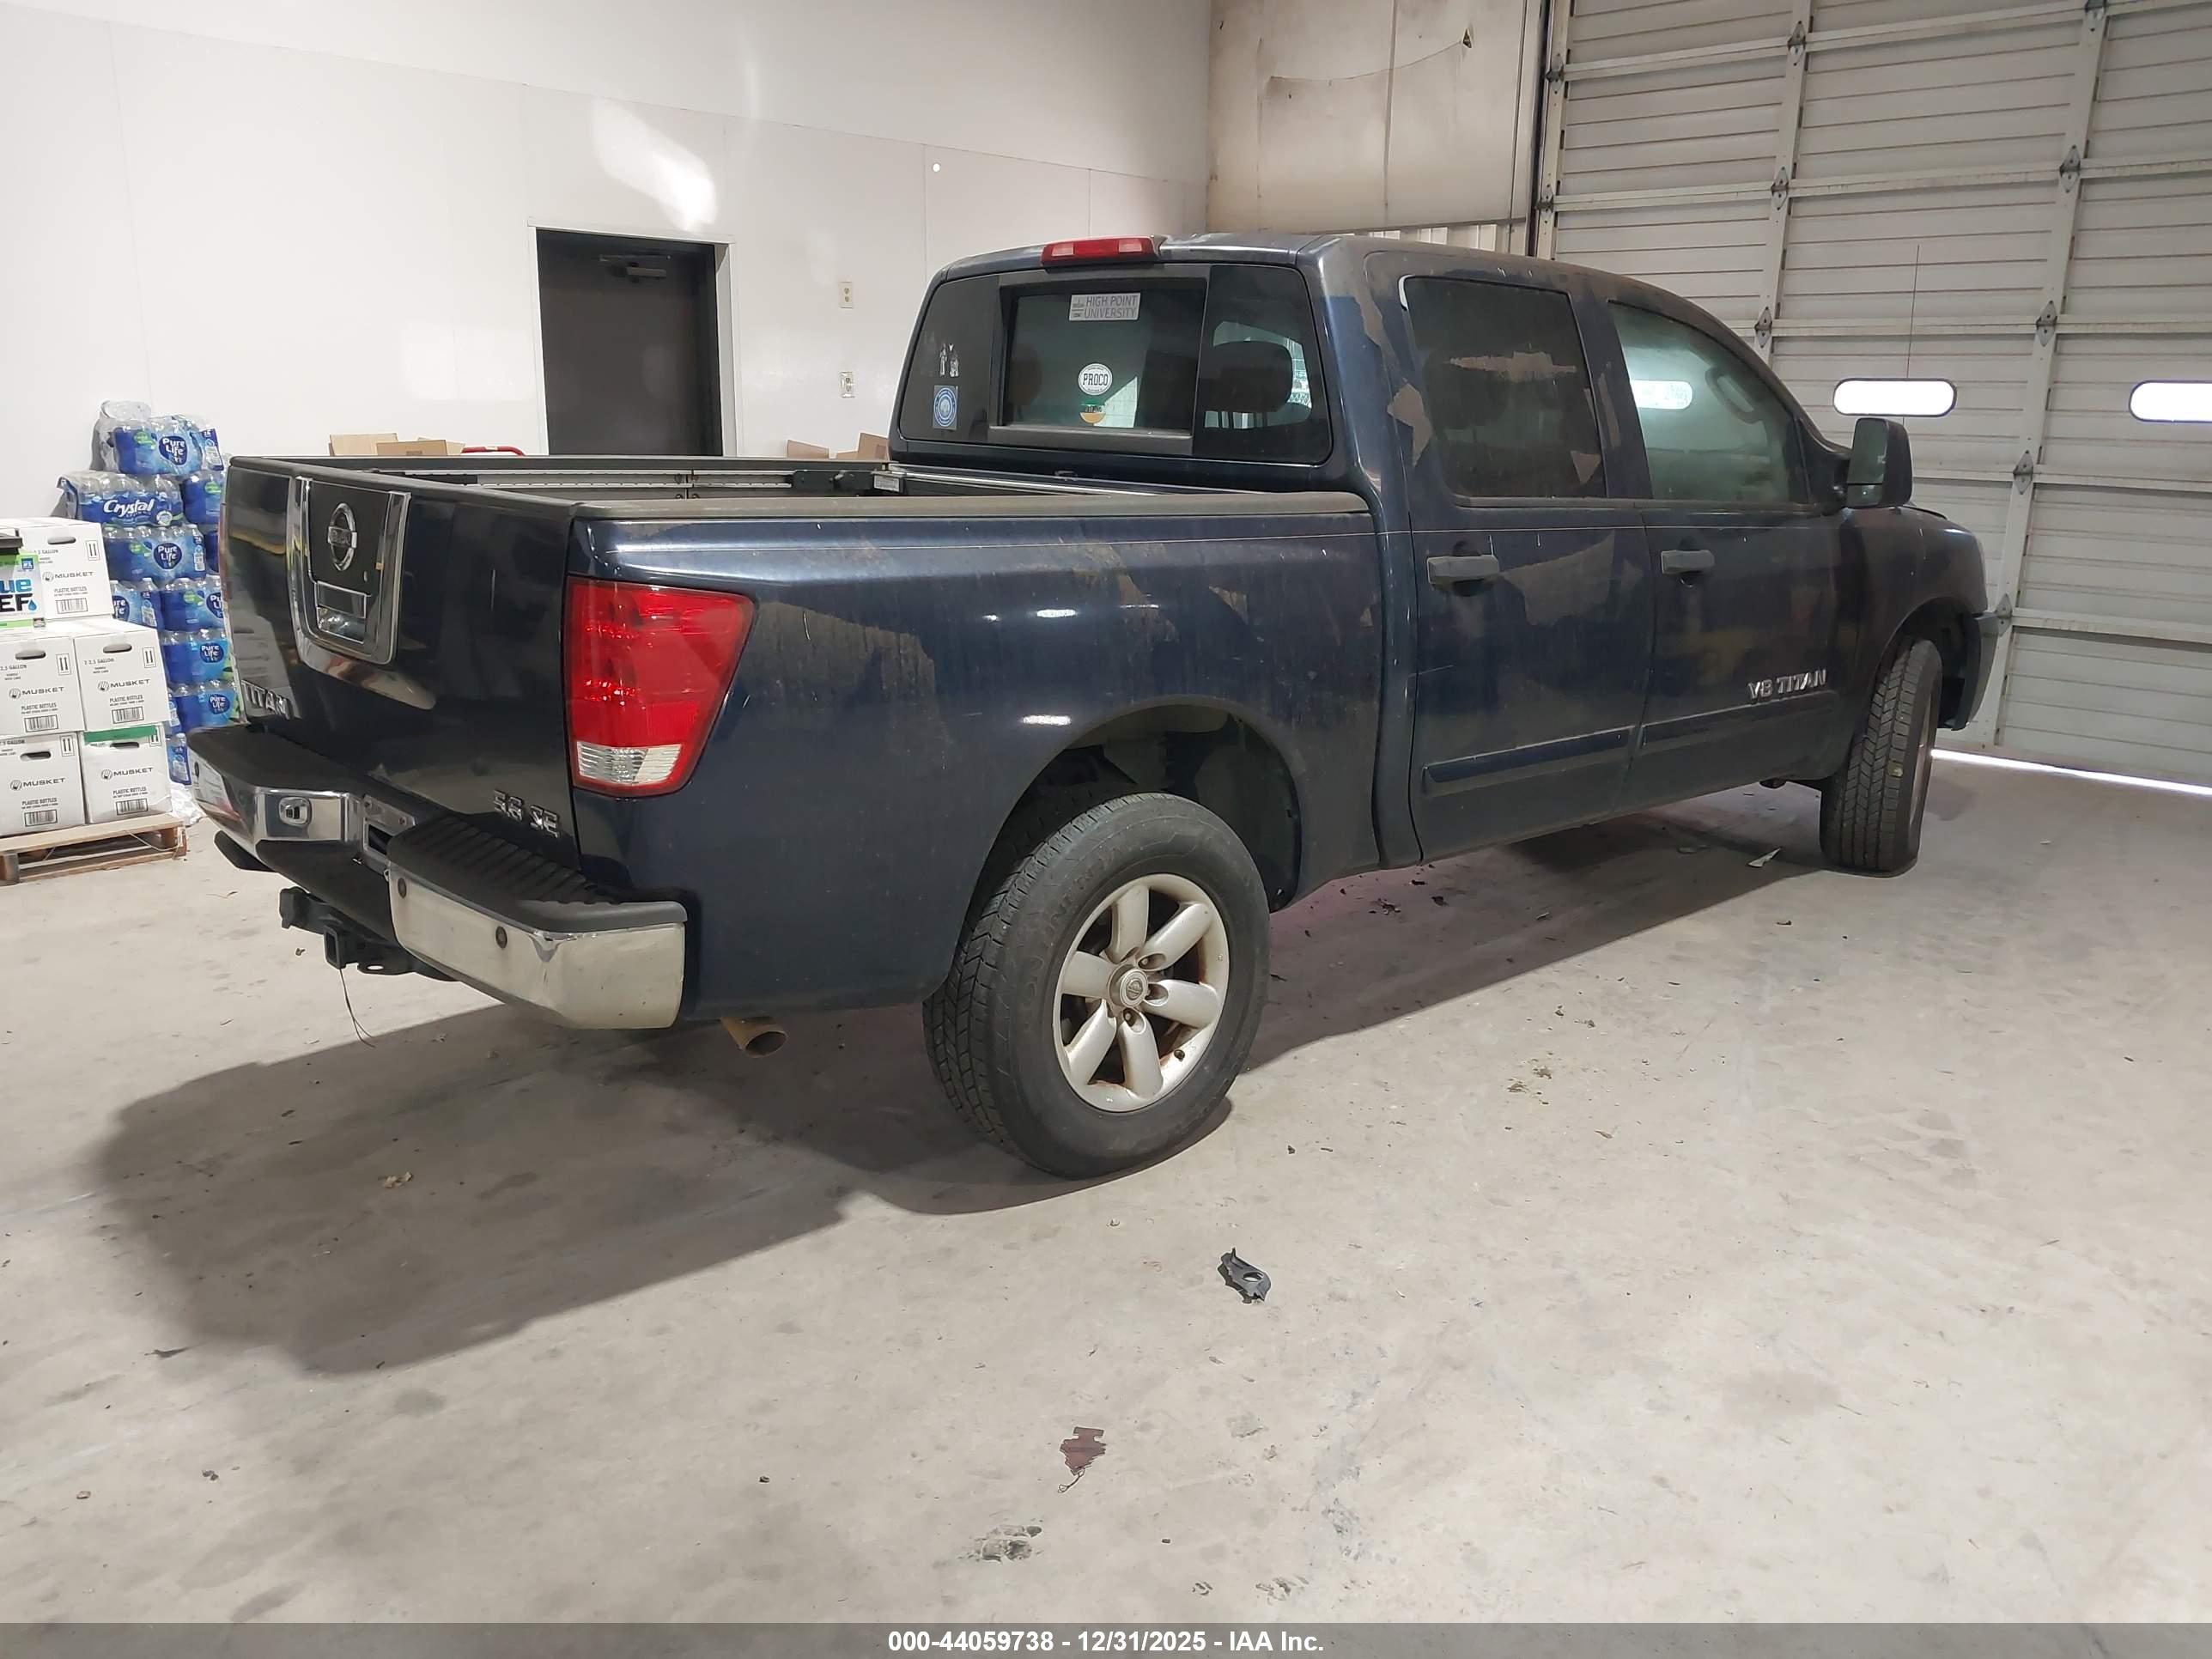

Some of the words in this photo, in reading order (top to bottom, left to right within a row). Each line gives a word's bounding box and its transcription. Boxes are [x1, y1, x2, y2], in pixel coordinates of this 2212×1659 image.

[1086, 296, 1108, 307] HIGH
[1109, 295, 1139, 307] POINT
[1085, 307, 1138, 319] UNIVERSITY
[1083, 373, 1109, 386] PROCO
[162, 438, 185, 447] Pure
[166, 446, 184, 456] Life
[104, 499, 155, 518] Crystal
[158, 545, 178, 554] Pure
[161, 552, 176, 562] Life
[204, 650, 218, 659] Life
[110, 678, 150, 688] MUSKET
[1747, 679, 1773, 699] V8
[1777, 669, 1826, 694] TITAN
[21, 686, 64, 695] MUSKET
[241, 680, 289, 720] TITAN
[113, 767, 154, 776] MUSKET
[23, 777, 65, 787] MUSKET
[530, 805, 558, 838] SE
